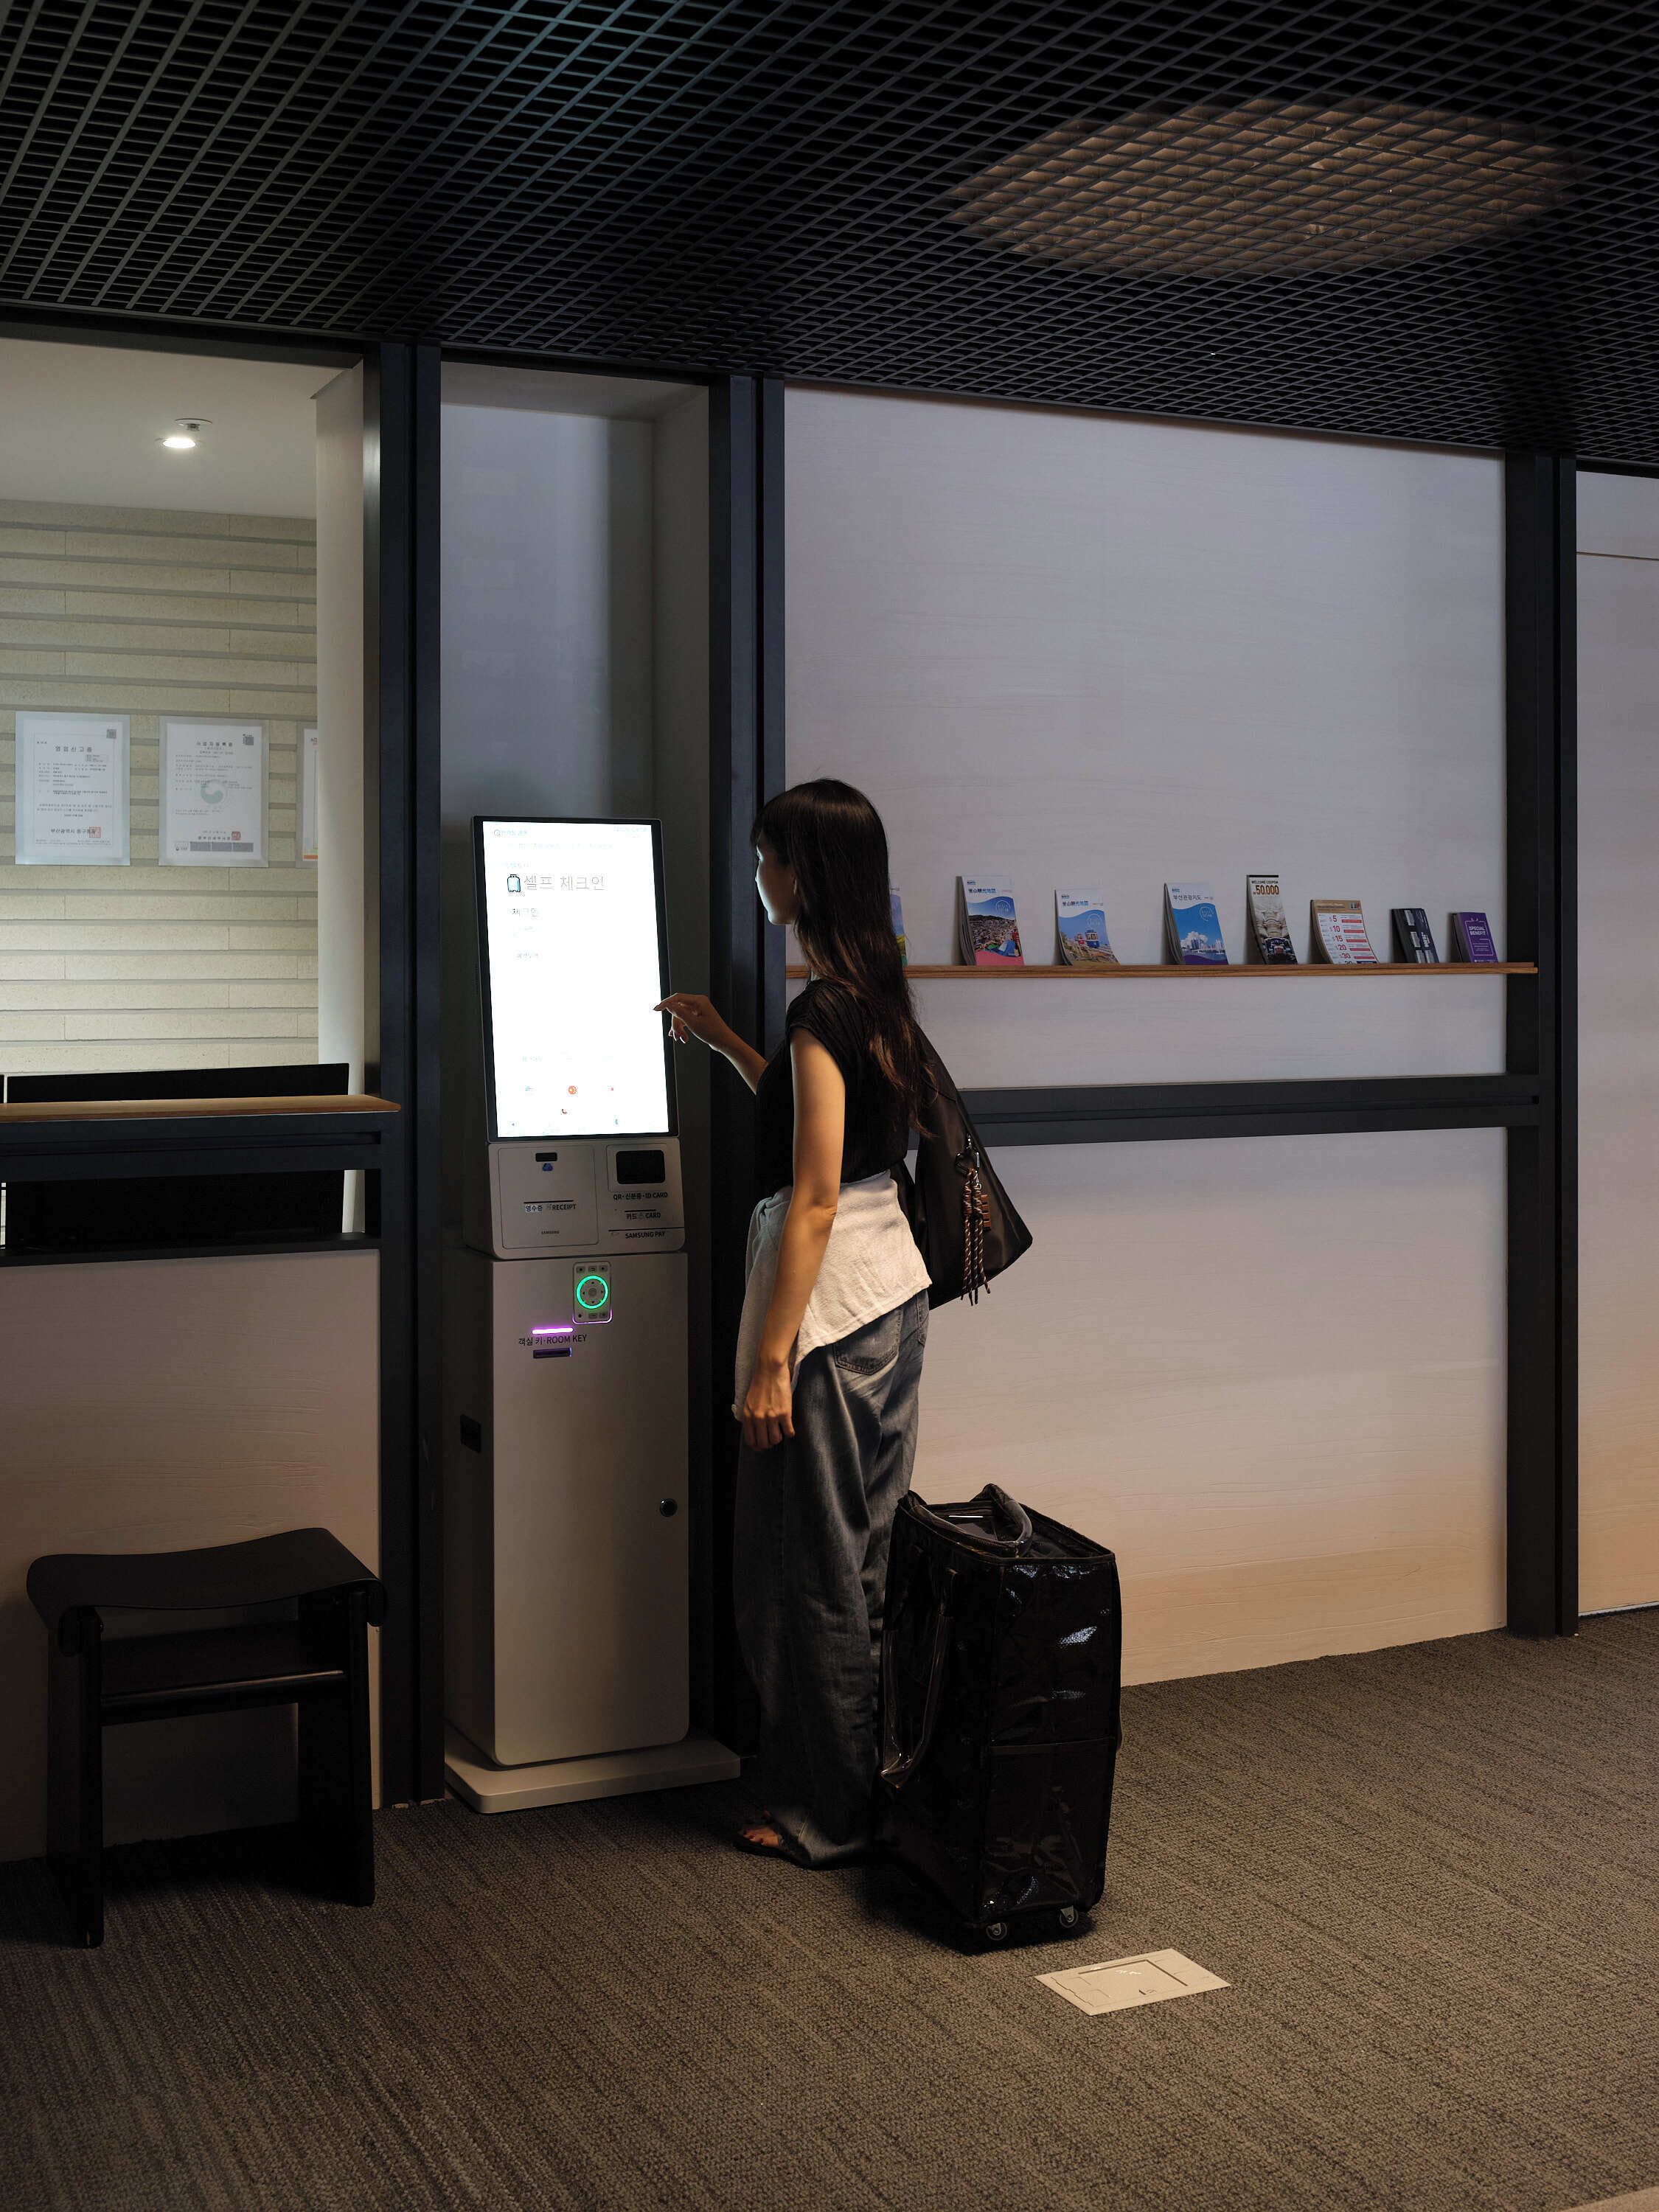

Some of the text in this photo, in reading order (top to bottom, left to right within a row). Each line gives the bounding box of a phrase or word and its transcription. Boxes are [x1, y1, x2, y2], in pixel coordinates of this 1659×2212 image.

[524, 874, 607, 891] 셀프 체크인
[525, 1204, 543, 1212] 영수증
[518, 1337, 533, 1346] 객실
[572, 1334, 587, 1343] KEY
